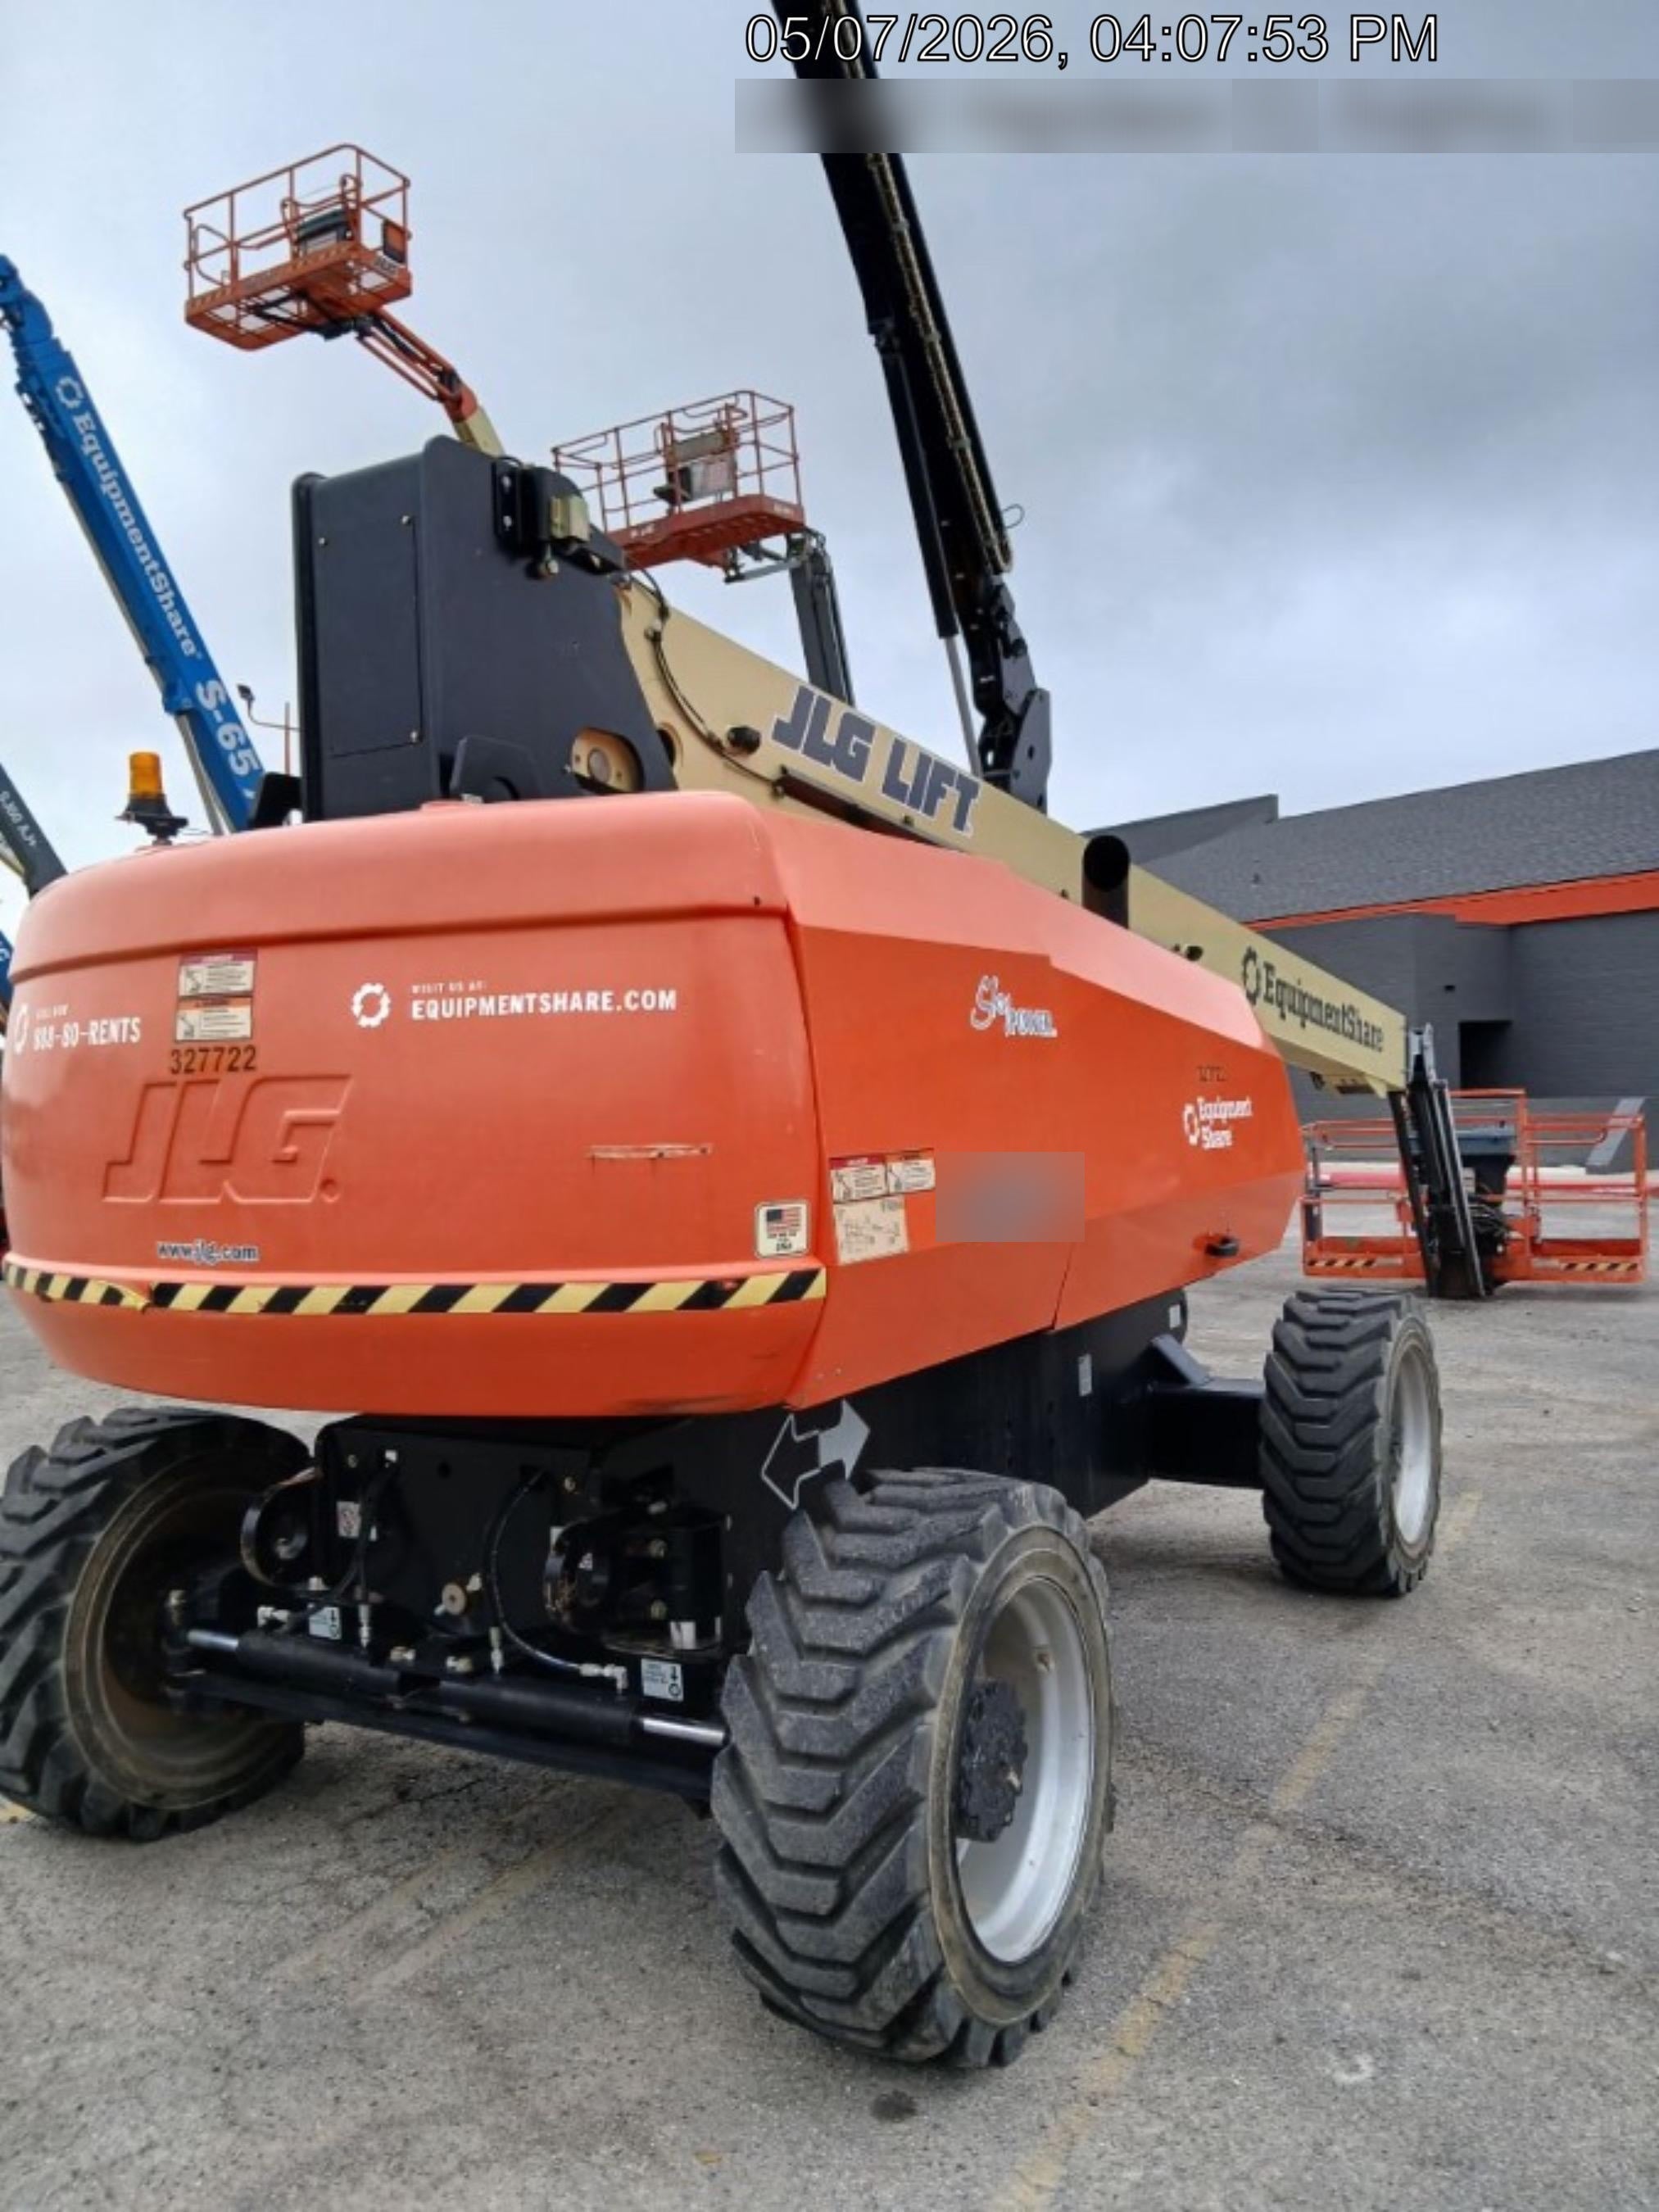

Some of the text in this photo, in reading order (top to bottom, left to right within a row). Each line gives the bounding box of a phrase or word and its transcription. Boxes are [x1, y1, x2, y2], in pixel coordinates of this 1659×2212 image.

[75, 411, 197, 657] EquipmentShare
[196, 678, 261, 776] S-65
[771, 684, 980, 832] JLG LIFT
[411, 989, 678, 1021] EQUIPMENTSHARE.COM
[1262, 960, 1384, 1053] EquipmentShare
[170, 1044, 256, 1075] 327722
[156, 1239, 260, 1266] www.jlg.com
